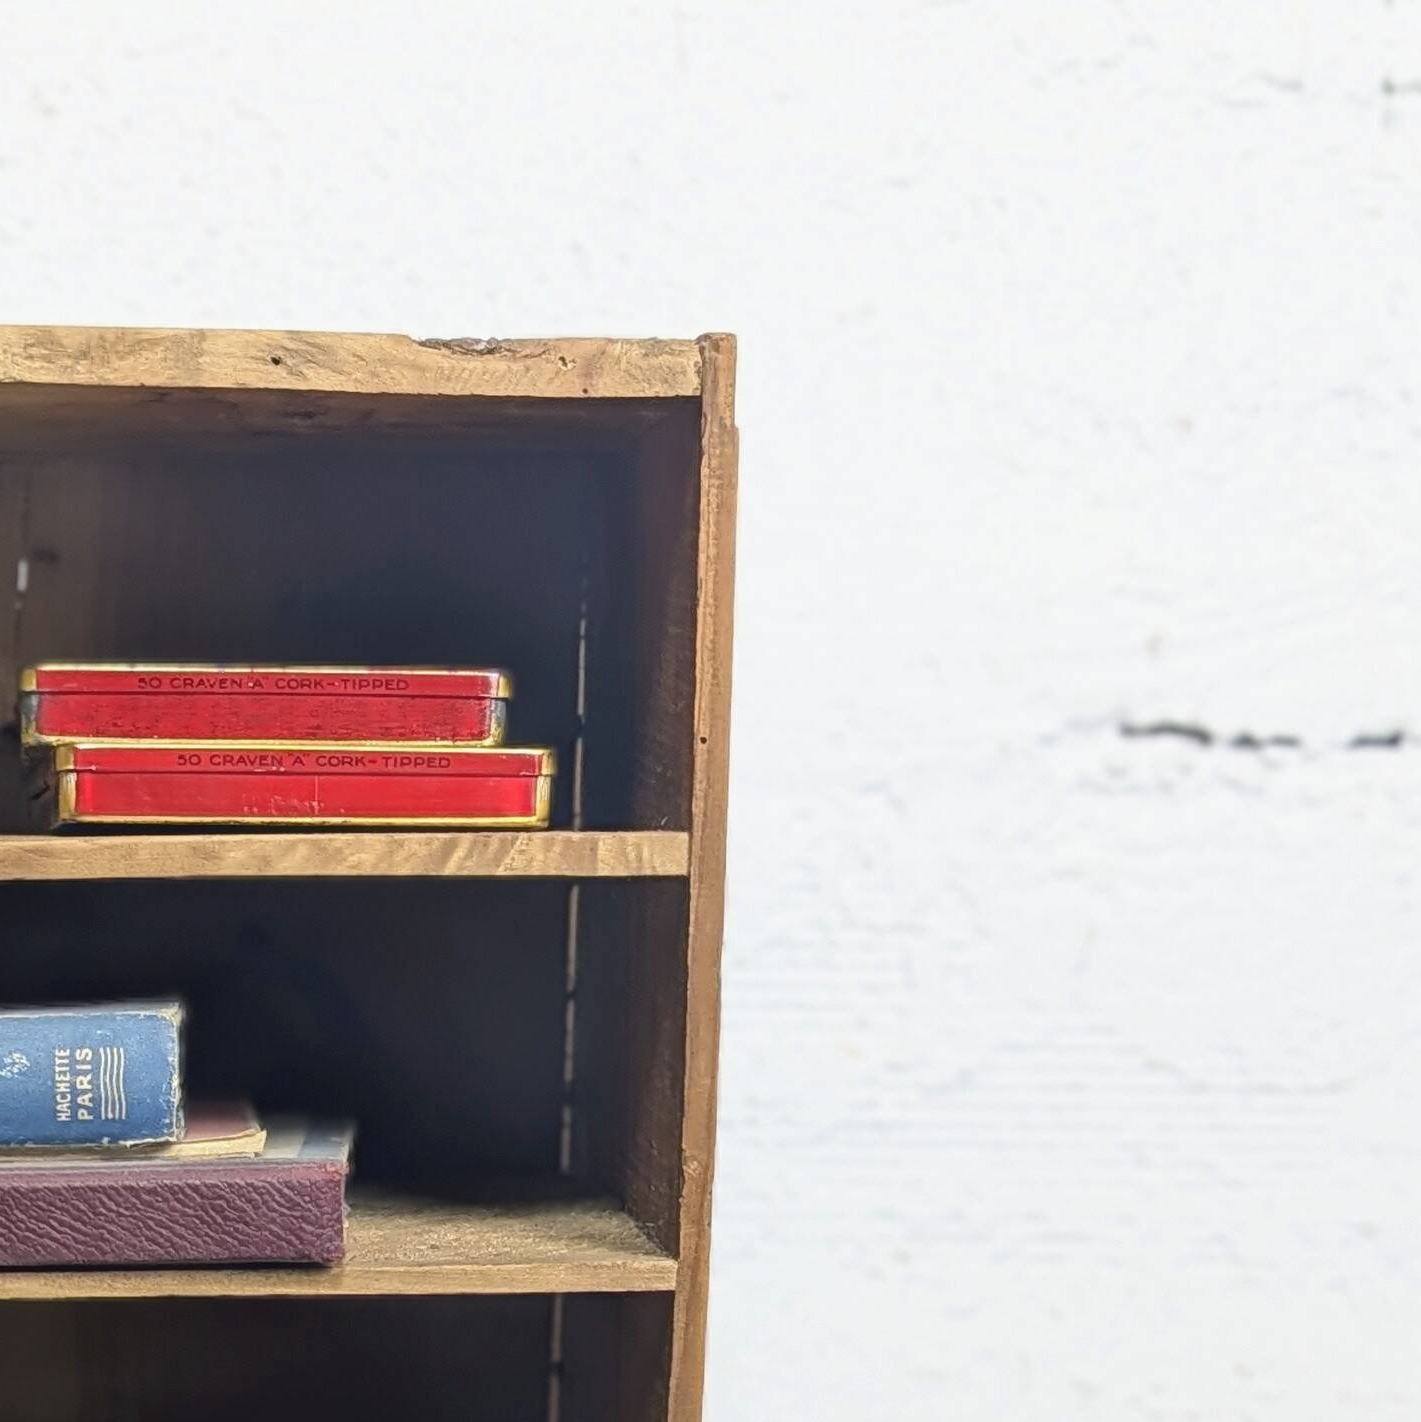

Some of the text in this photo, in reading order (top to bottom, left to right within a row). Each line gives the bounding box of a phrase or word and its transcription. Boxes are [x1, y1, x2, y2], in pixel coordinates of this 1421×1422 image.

[137, 677, 162, 689] 50
[170, 677, 247, 690] CRAVEN
[176, 754, 201, 767] 50
[209, 754, 283, 768] CRAVEN
[54, 1048, 72, 1122] HACHETTE
[75, 1047, 94, 1121] PARIS
